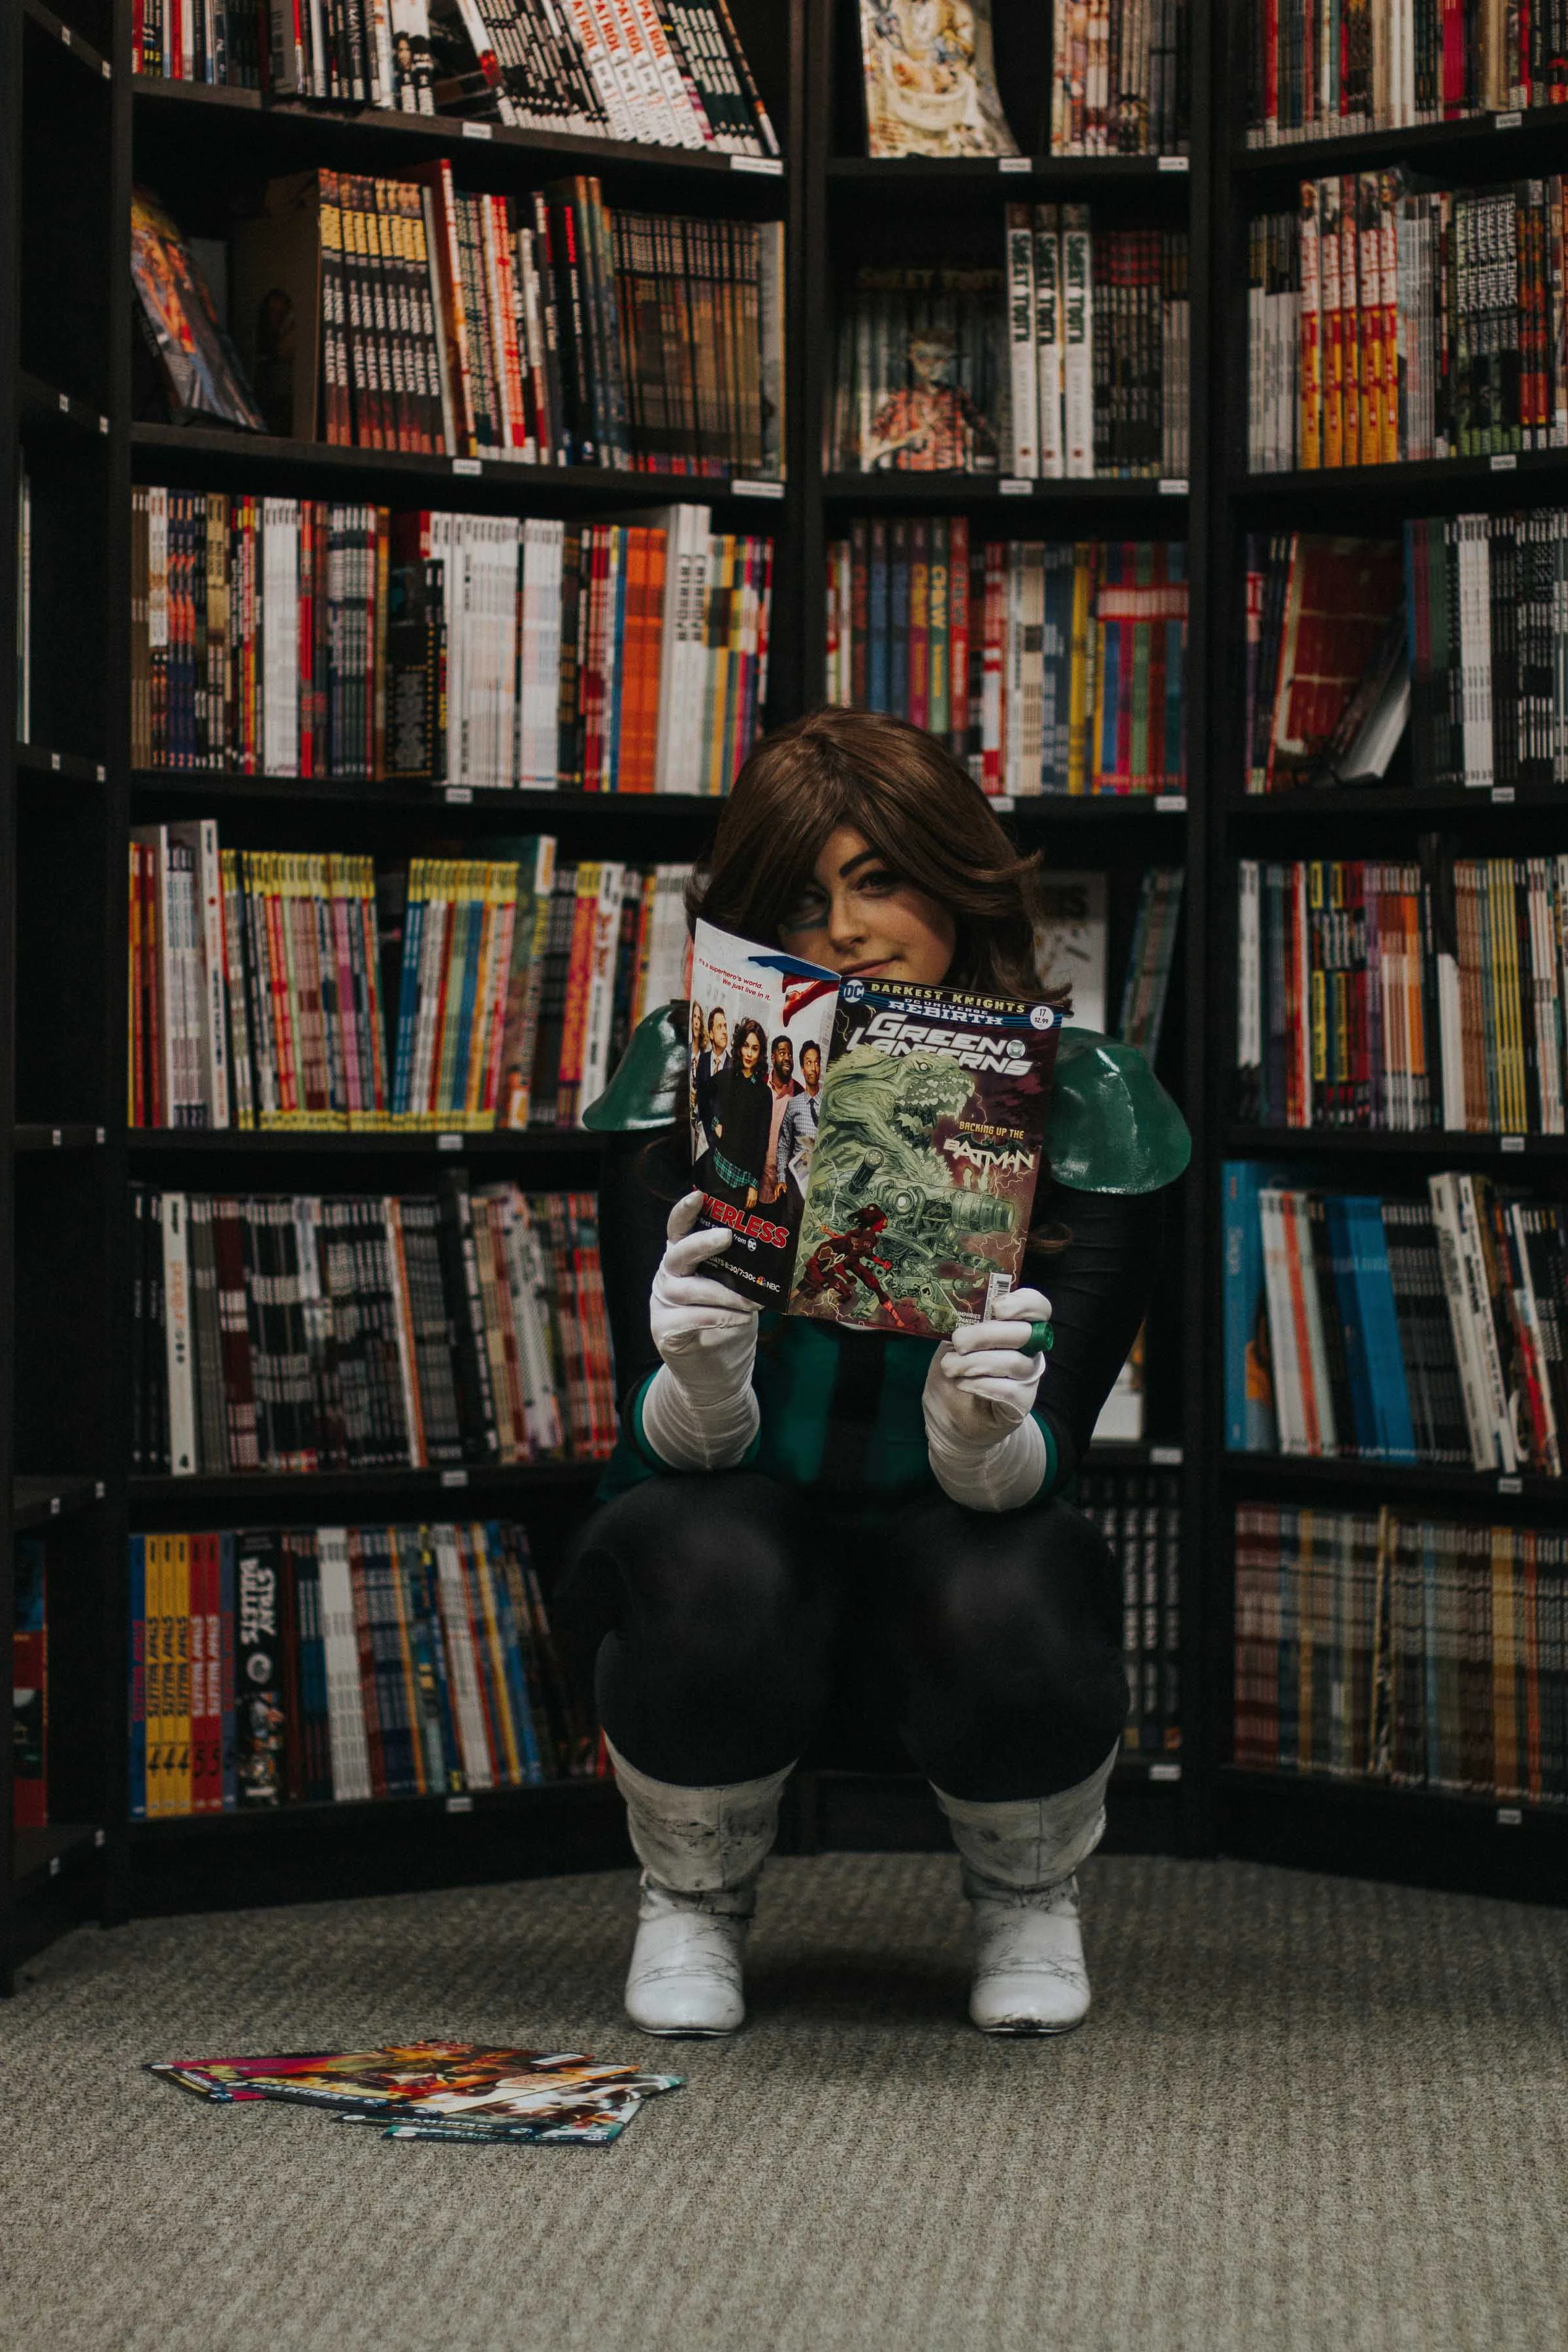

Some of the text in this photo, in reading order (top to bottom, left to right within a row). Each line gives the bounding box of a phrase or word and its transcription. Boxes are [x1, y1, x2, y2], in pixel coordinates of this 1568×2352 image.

[573, 0, 598, 49] ATROL
[594, 0, 621, 52] ATROL
[637, 1, 667, 59] PATROL
[1012, 234, 1030, 286] SWEET
[1035, 237, 1056, 289] SWEET
[1068, 237, 1086, 289] SWEET
[1457, 209, 1467, 313] SWAMP THING
[1468, 207, 1478, 310] SWAMP THING
[1478, 206, 1488, 309] SWAMP THING
[1499, 203, 1507, 306] SWAMP THING
[1507, 201, 1517, 304] SWAMP THING
[1490, 264, 1498, 308] THING
[710, 965, 742, 981] superhero's
[743, 977, 763, 990] world.
[723, 978, 731, 987] We
[732, 980, 744, 992] just
[745, 985, 757, 996] live
[844, 984, 864, 1000] DC
[871, 983, 1025, 1013] DARKEST KNIGHTS
[888, 1000, 1004, 1025] REBIRTH
[924, 1001, 988, 1015] UNIVERSE
[1034, 1017, 1049, 1025] $2.99
[866, 1012, 1008, 1056] GREEN
[959, 1121, 1025, 1139] BACKING UP THE
[943, 1138, 1035, 1180] BATMAN
[702, 1193, 789, 1249] WERLESS
[733, 1233, 746, 1245] from
[710, 1256, 725, 1266] DAYS
[725, 1262, 756, 1282] 8:30/7:30c
[766, 1282, 780, 1292] NBC
[953, 1311, 981, 1320] HUMPHRIES
[239, 1558, 259, 1645] BULLETS
[256, 1568, 276, 1636] STRAY
